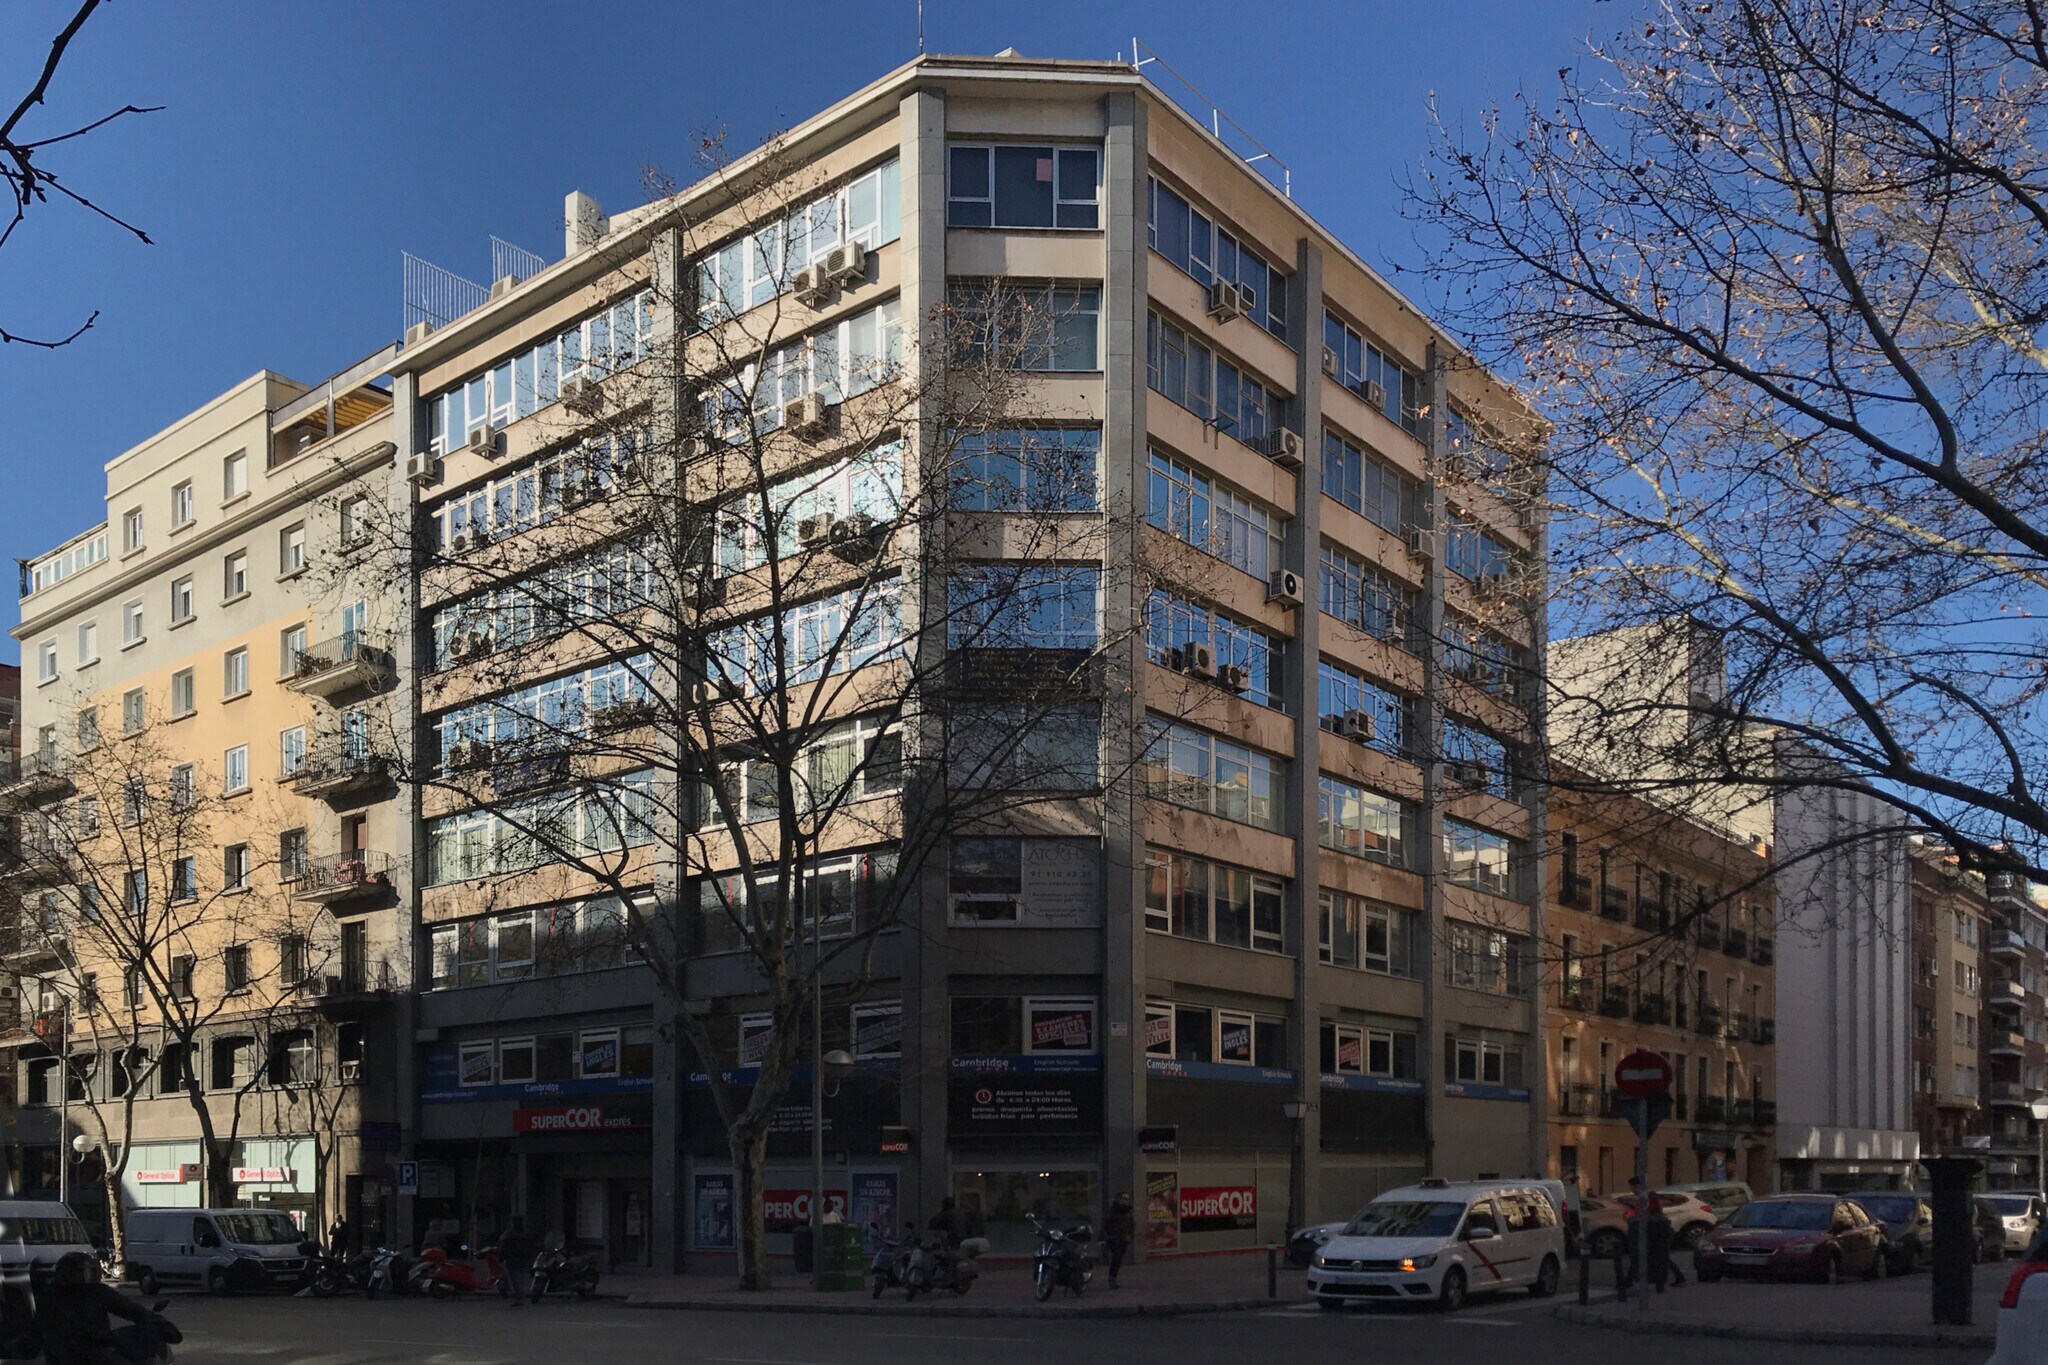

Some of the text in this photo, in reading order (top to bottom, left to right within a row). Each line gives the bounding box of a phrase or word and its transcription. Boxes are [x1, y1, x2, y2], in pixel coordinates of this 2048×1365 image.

[952, 1058, 1010, 1067] Cambridge
[1147, 1059, 1182, 1072] Cambridge
[525, 1084, 558, 1093] Cambridge
[531, 1108, 630, 1129] SUPERCOR exprés
[1181, 1191, 1254, 1217] SUPERCOR
